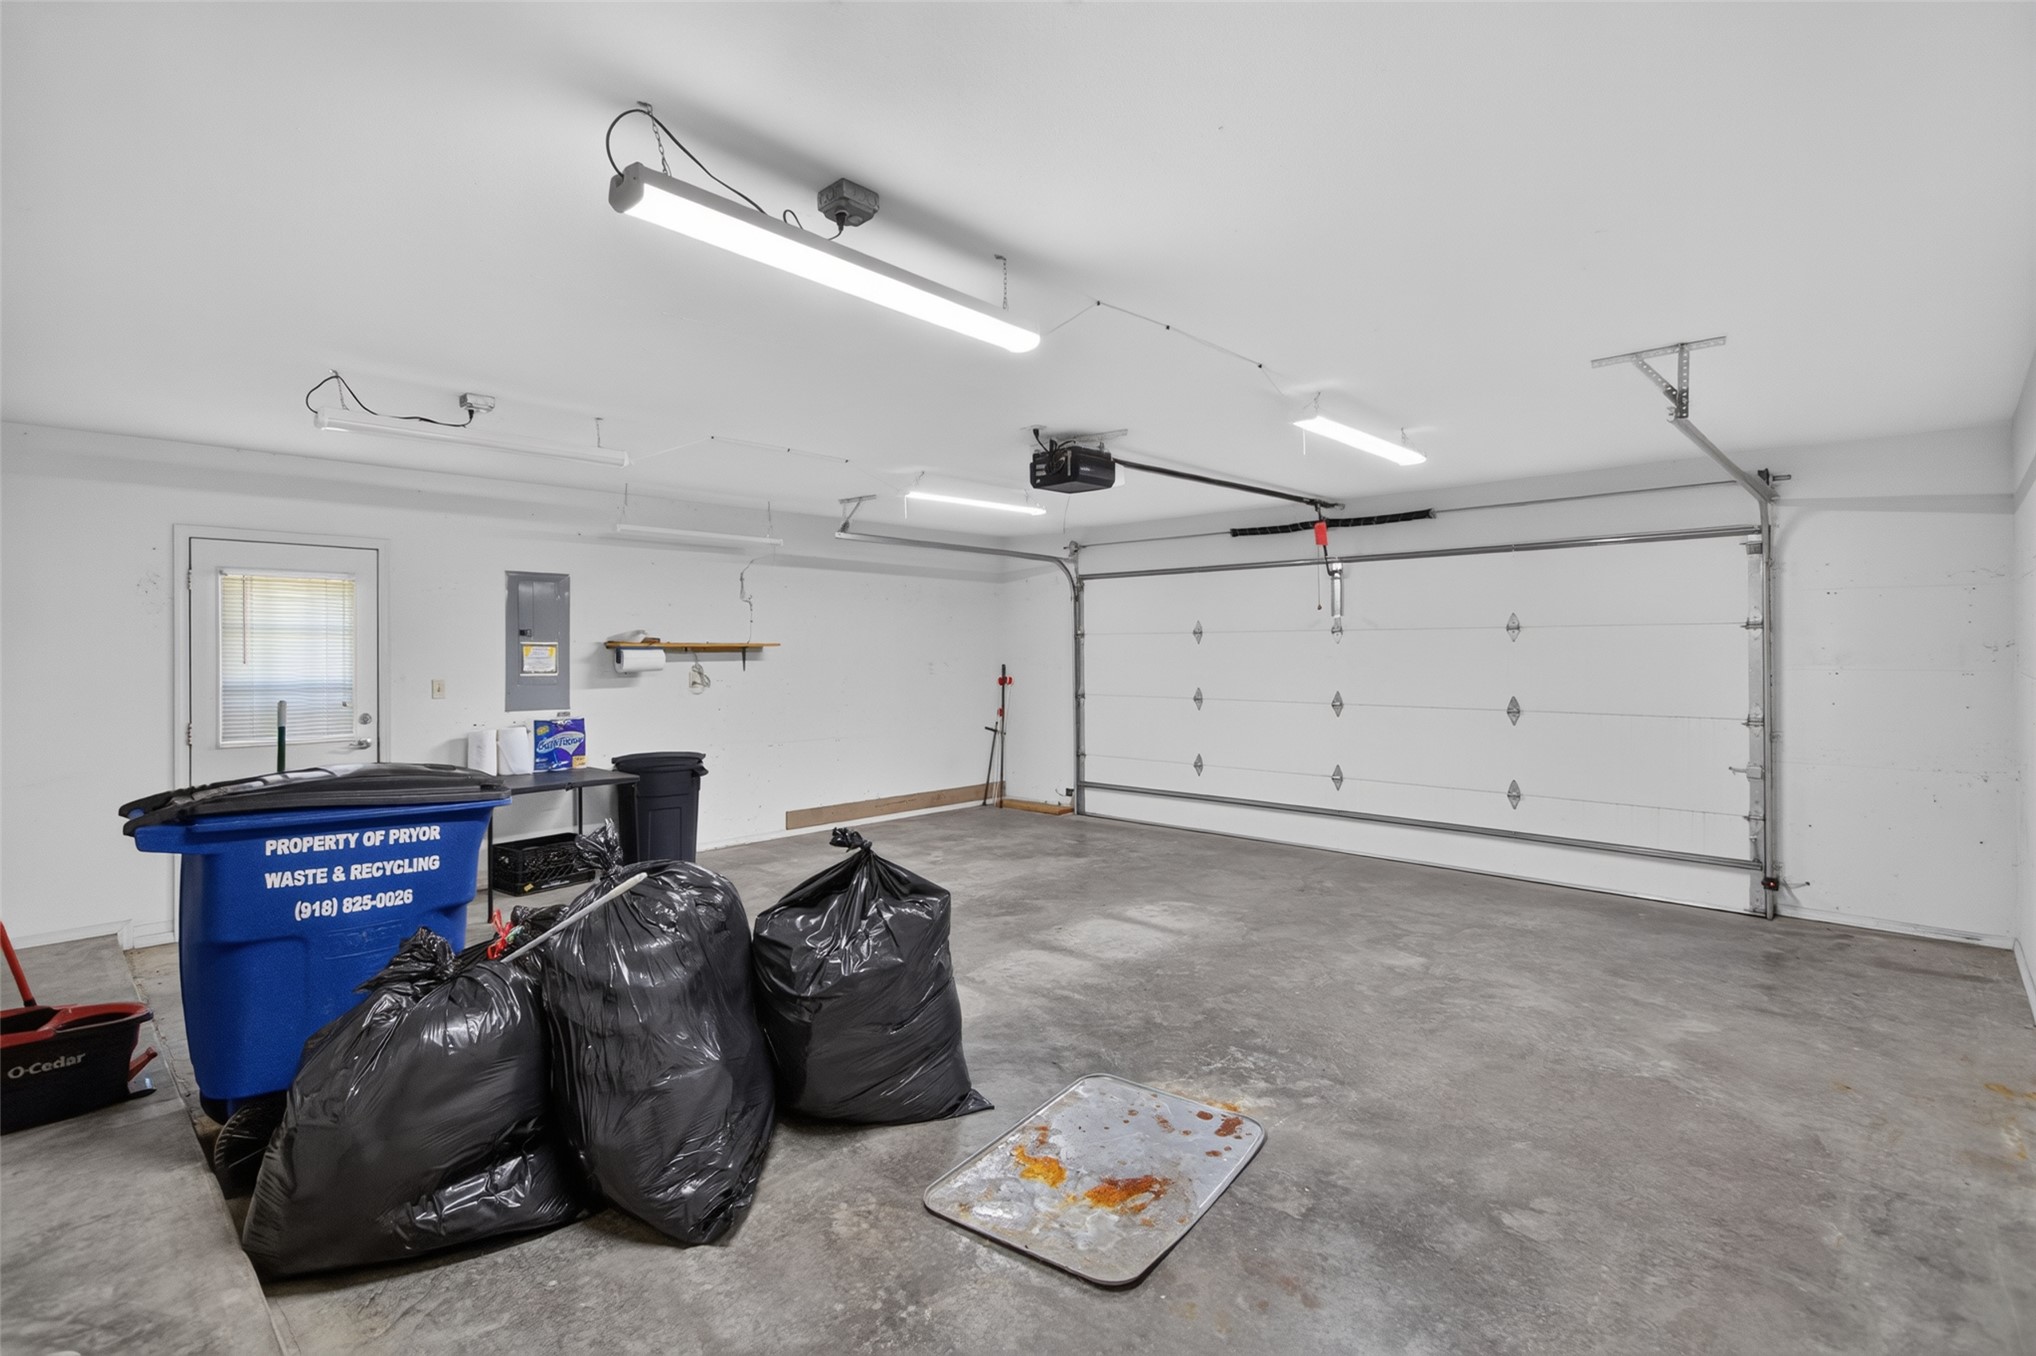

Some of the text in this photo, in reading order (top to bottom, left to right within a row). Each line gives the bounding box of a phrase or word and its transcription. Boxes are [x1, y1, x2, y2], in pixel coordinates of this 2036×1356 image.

[265, 825, 441, 856] PROPERTY OF PRYOR
[264, 855, 440, 889] WASTE & RECYCLING
[294, 888, 414, 921] (918) 825-0026
[7, 1052, 86, 1079] O-Cedar
